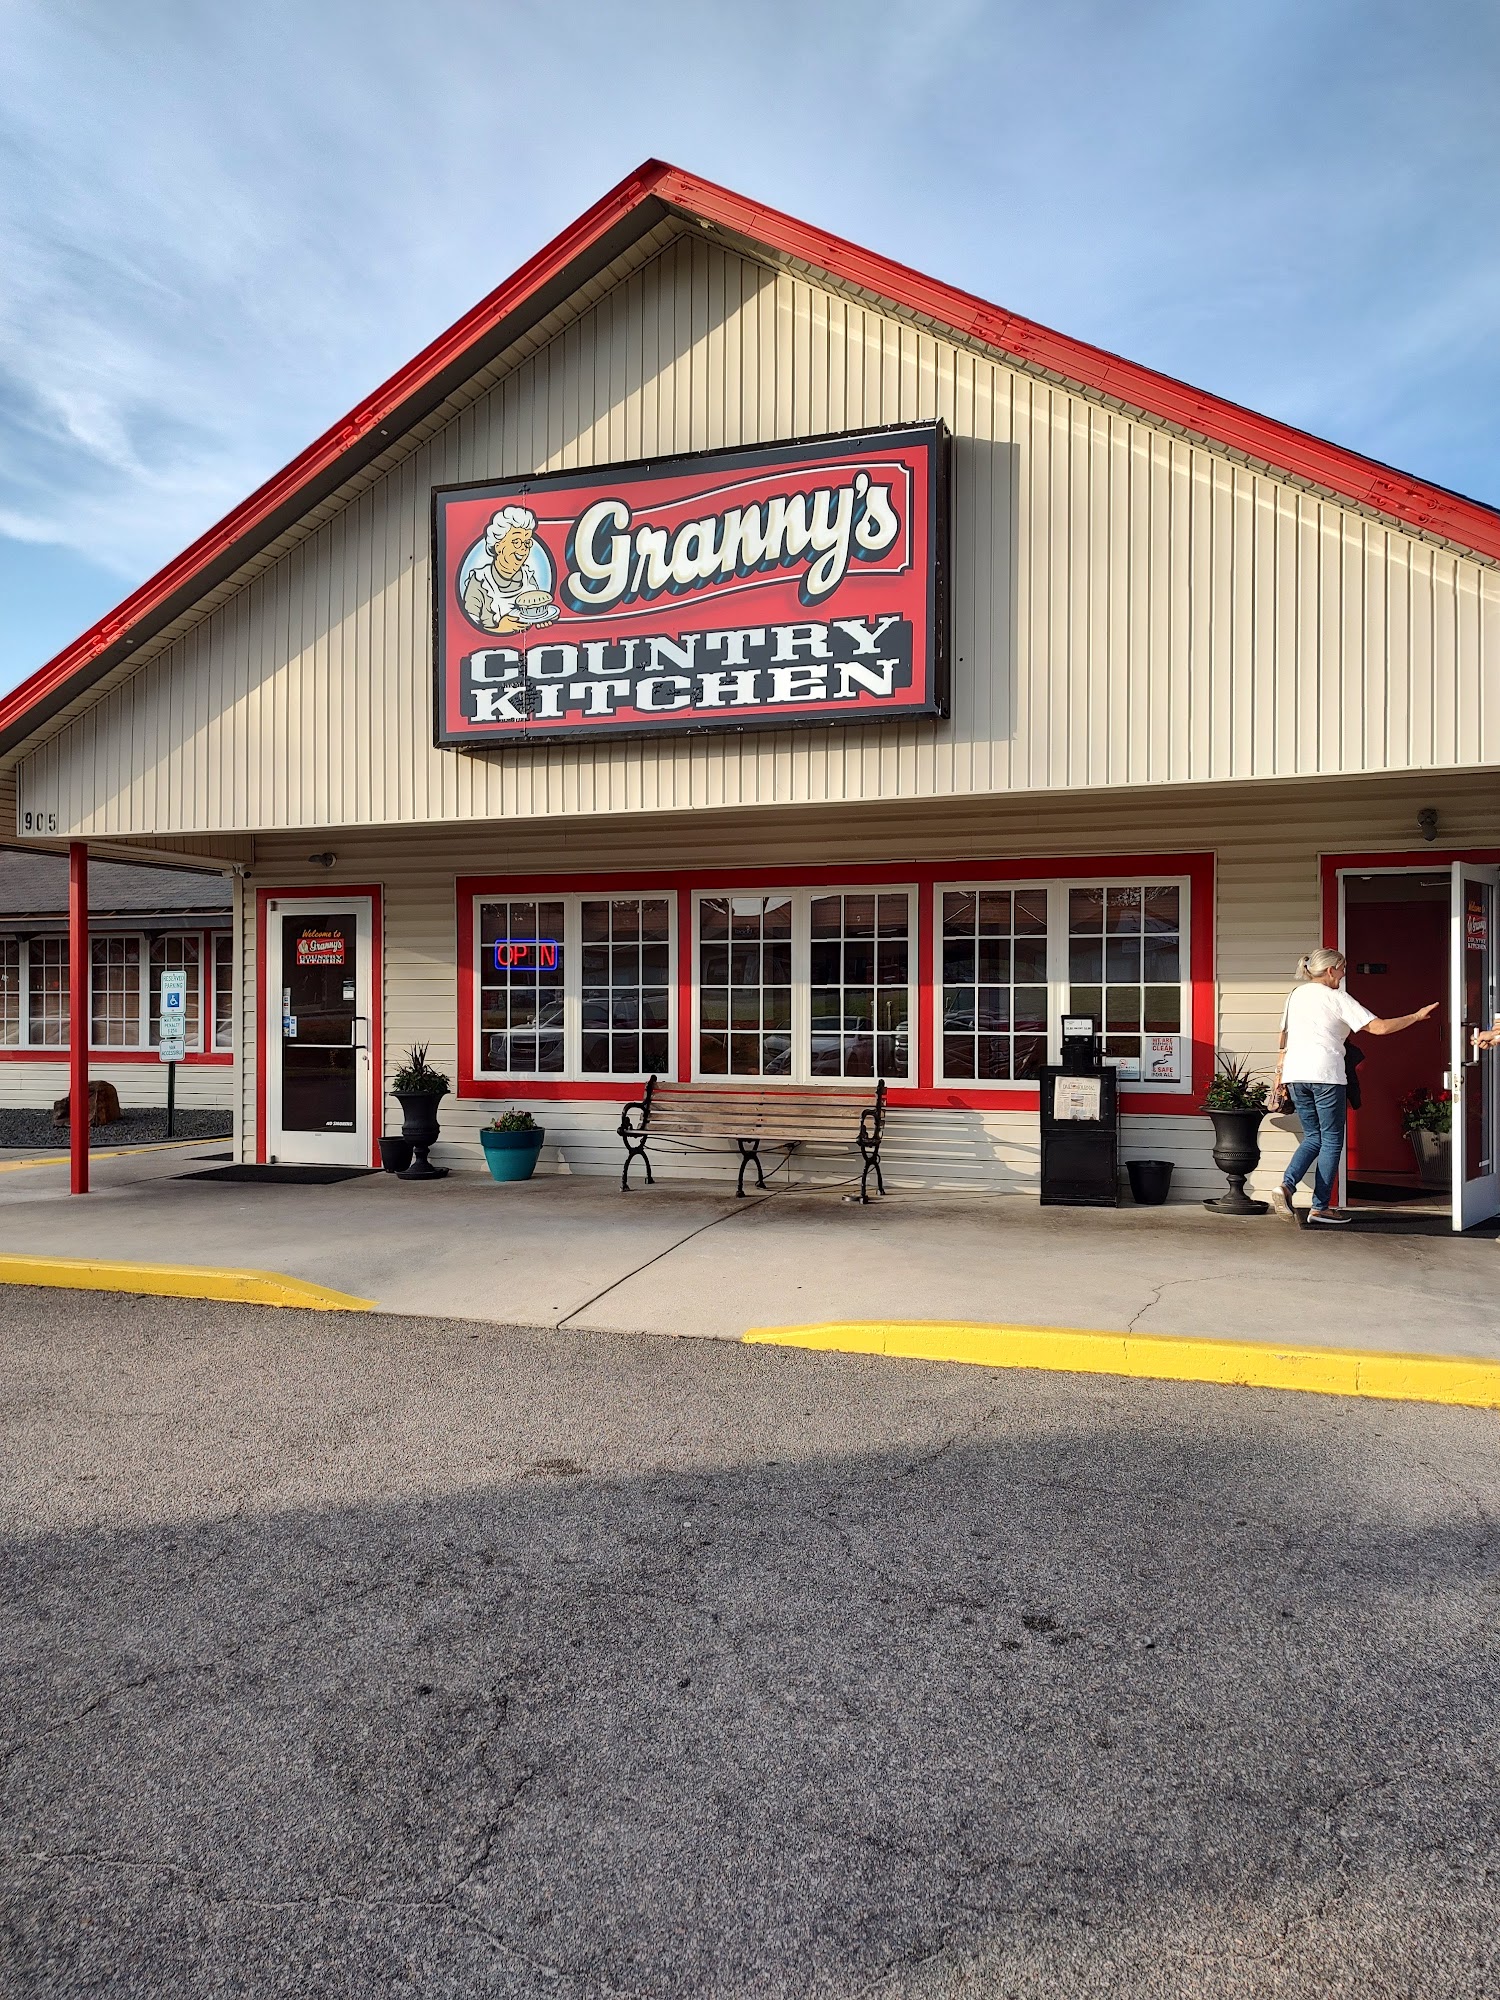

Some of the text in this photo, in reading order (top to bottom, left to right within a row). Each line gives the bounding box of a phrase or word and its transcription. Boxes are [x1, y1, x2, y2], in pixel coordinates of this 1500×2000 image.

[566, 473, 898, 595] Granny's
[469, 615, 900, 684] COUNTRY
[469, 658, 899, 723] KITCHEN
[25, 811, 56, 832] 905
[302, 929, 331, 937] Welcome
[310, 940, 342, 952] Granny's
